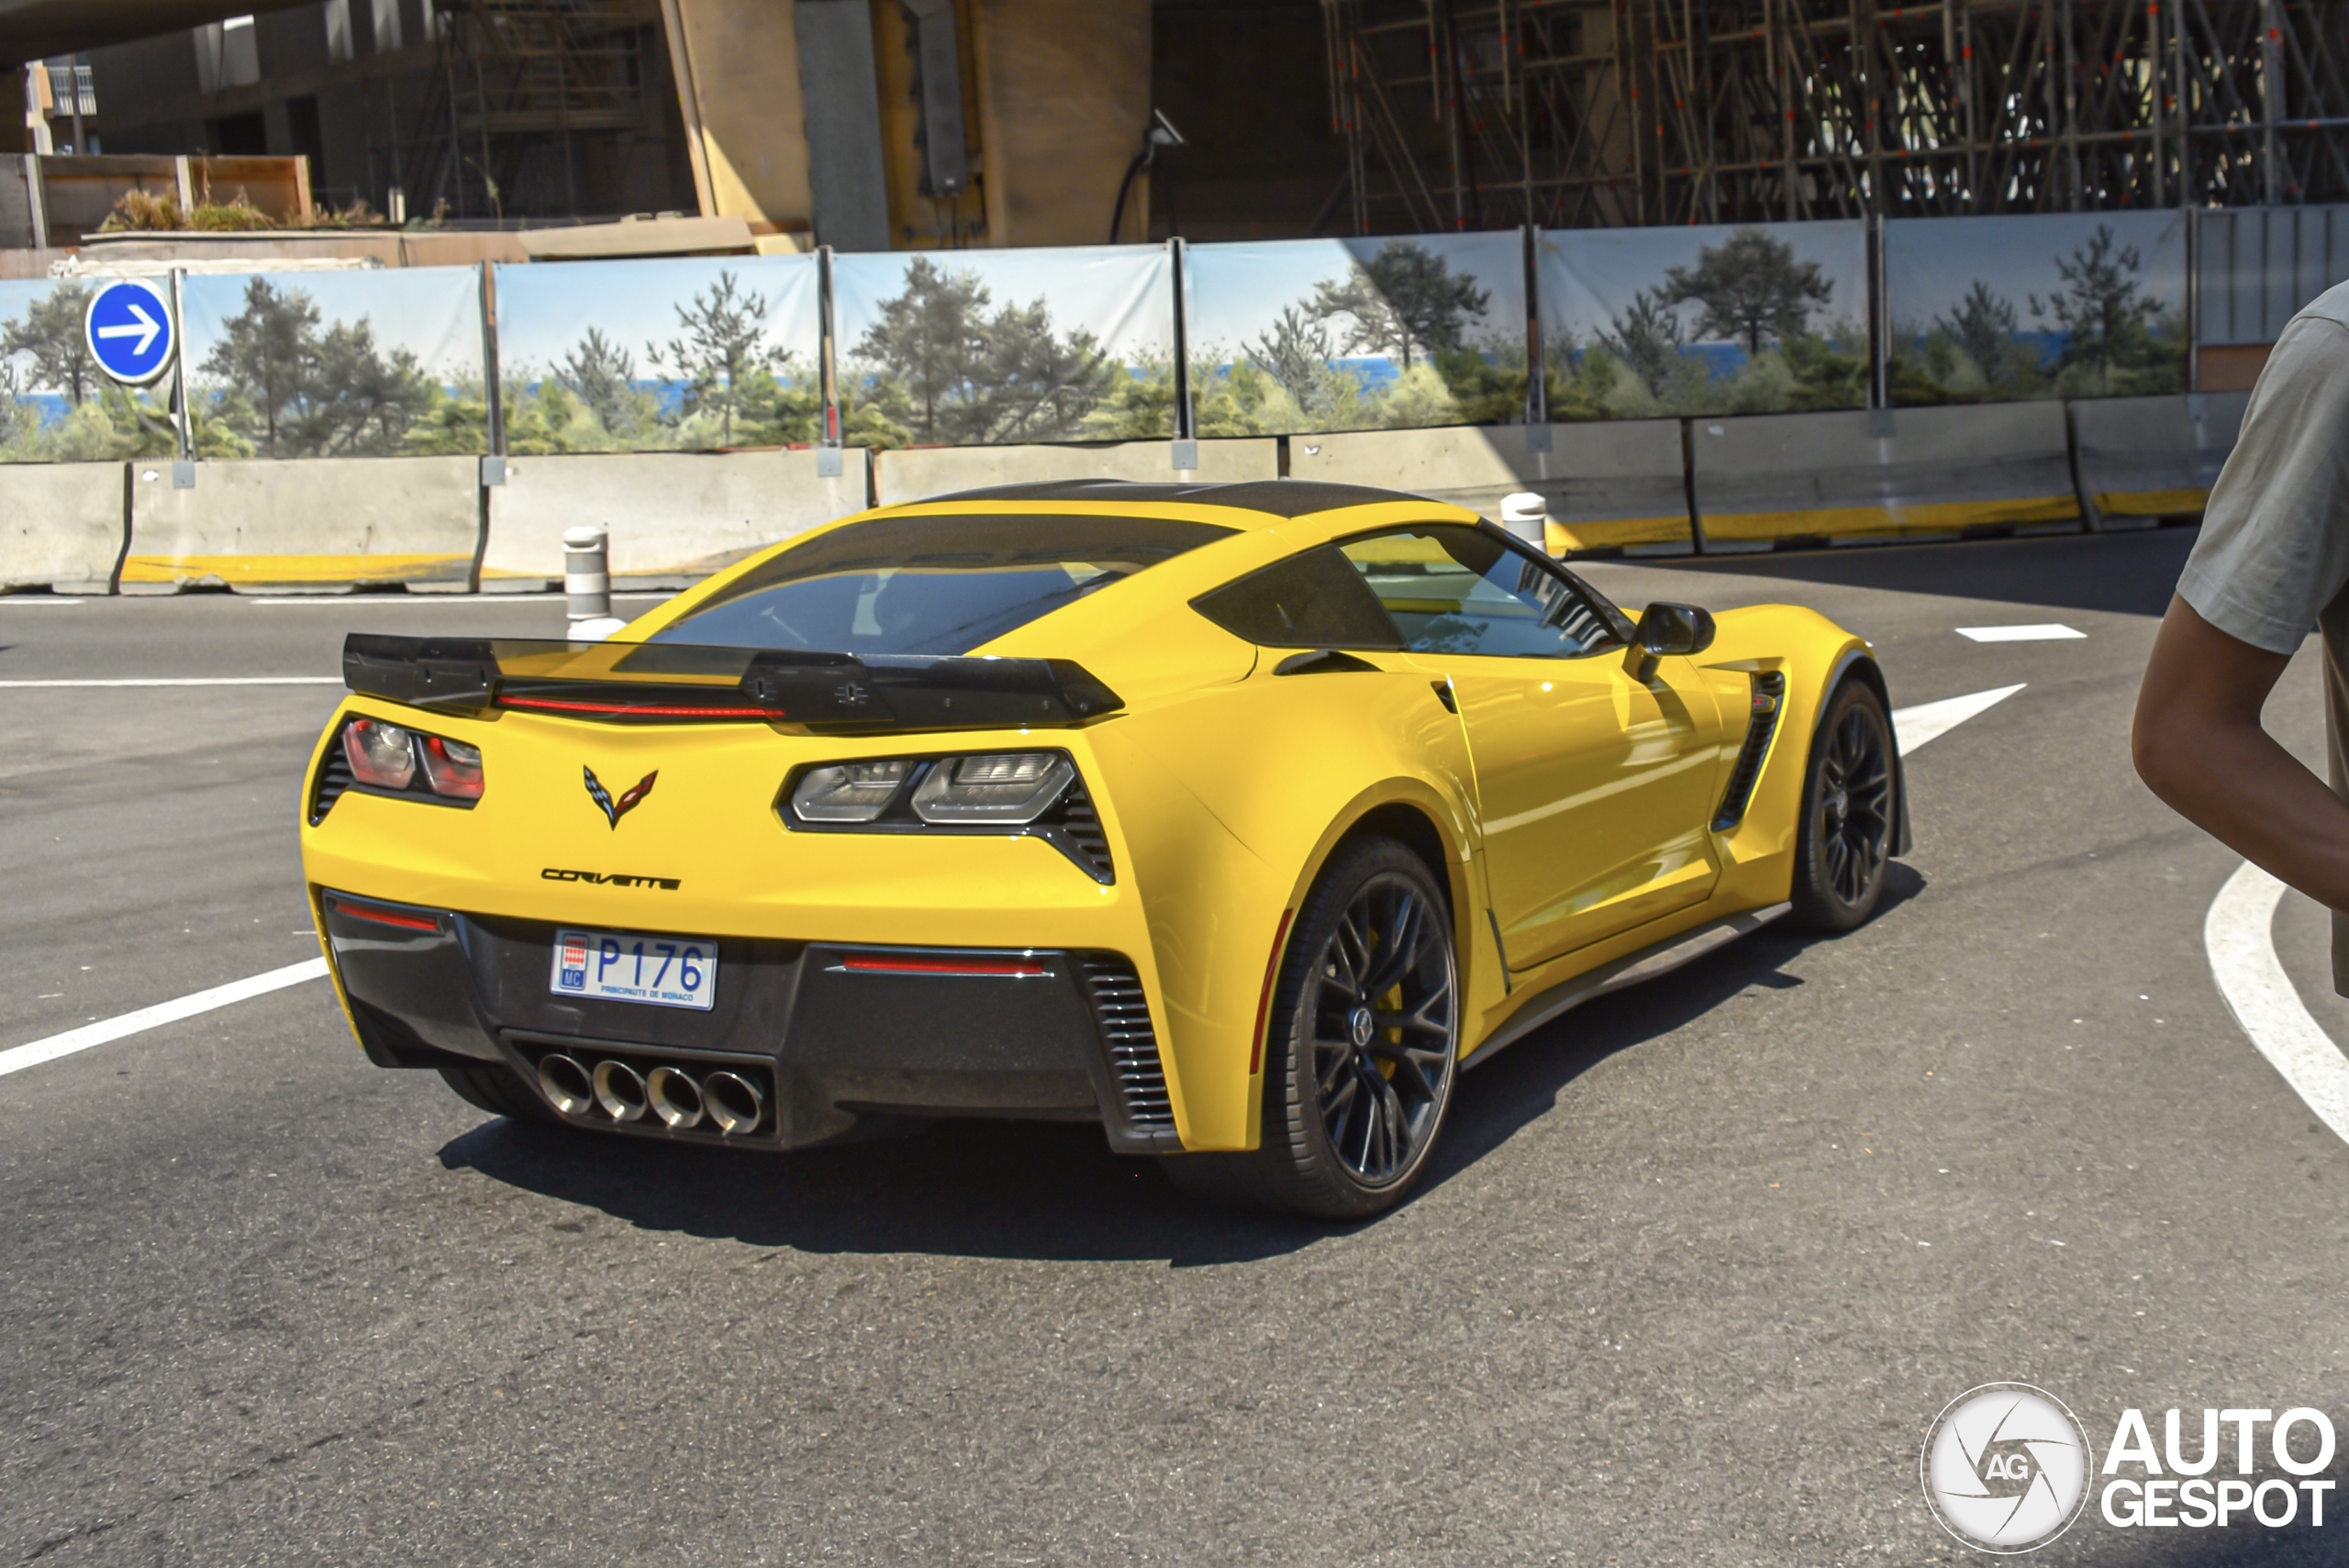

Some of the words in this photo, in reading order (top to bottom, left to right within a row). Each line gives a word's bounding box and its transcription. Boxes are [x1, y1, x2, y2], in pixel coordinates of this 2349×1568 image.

[541, 868, 681, 891] CORVETTE
[598, 938, 704, 992] P176
[564, 971, 581, 986] MC
[650, 990, 659, 998] DE
[662, 992, 694, 1002] MONACO
